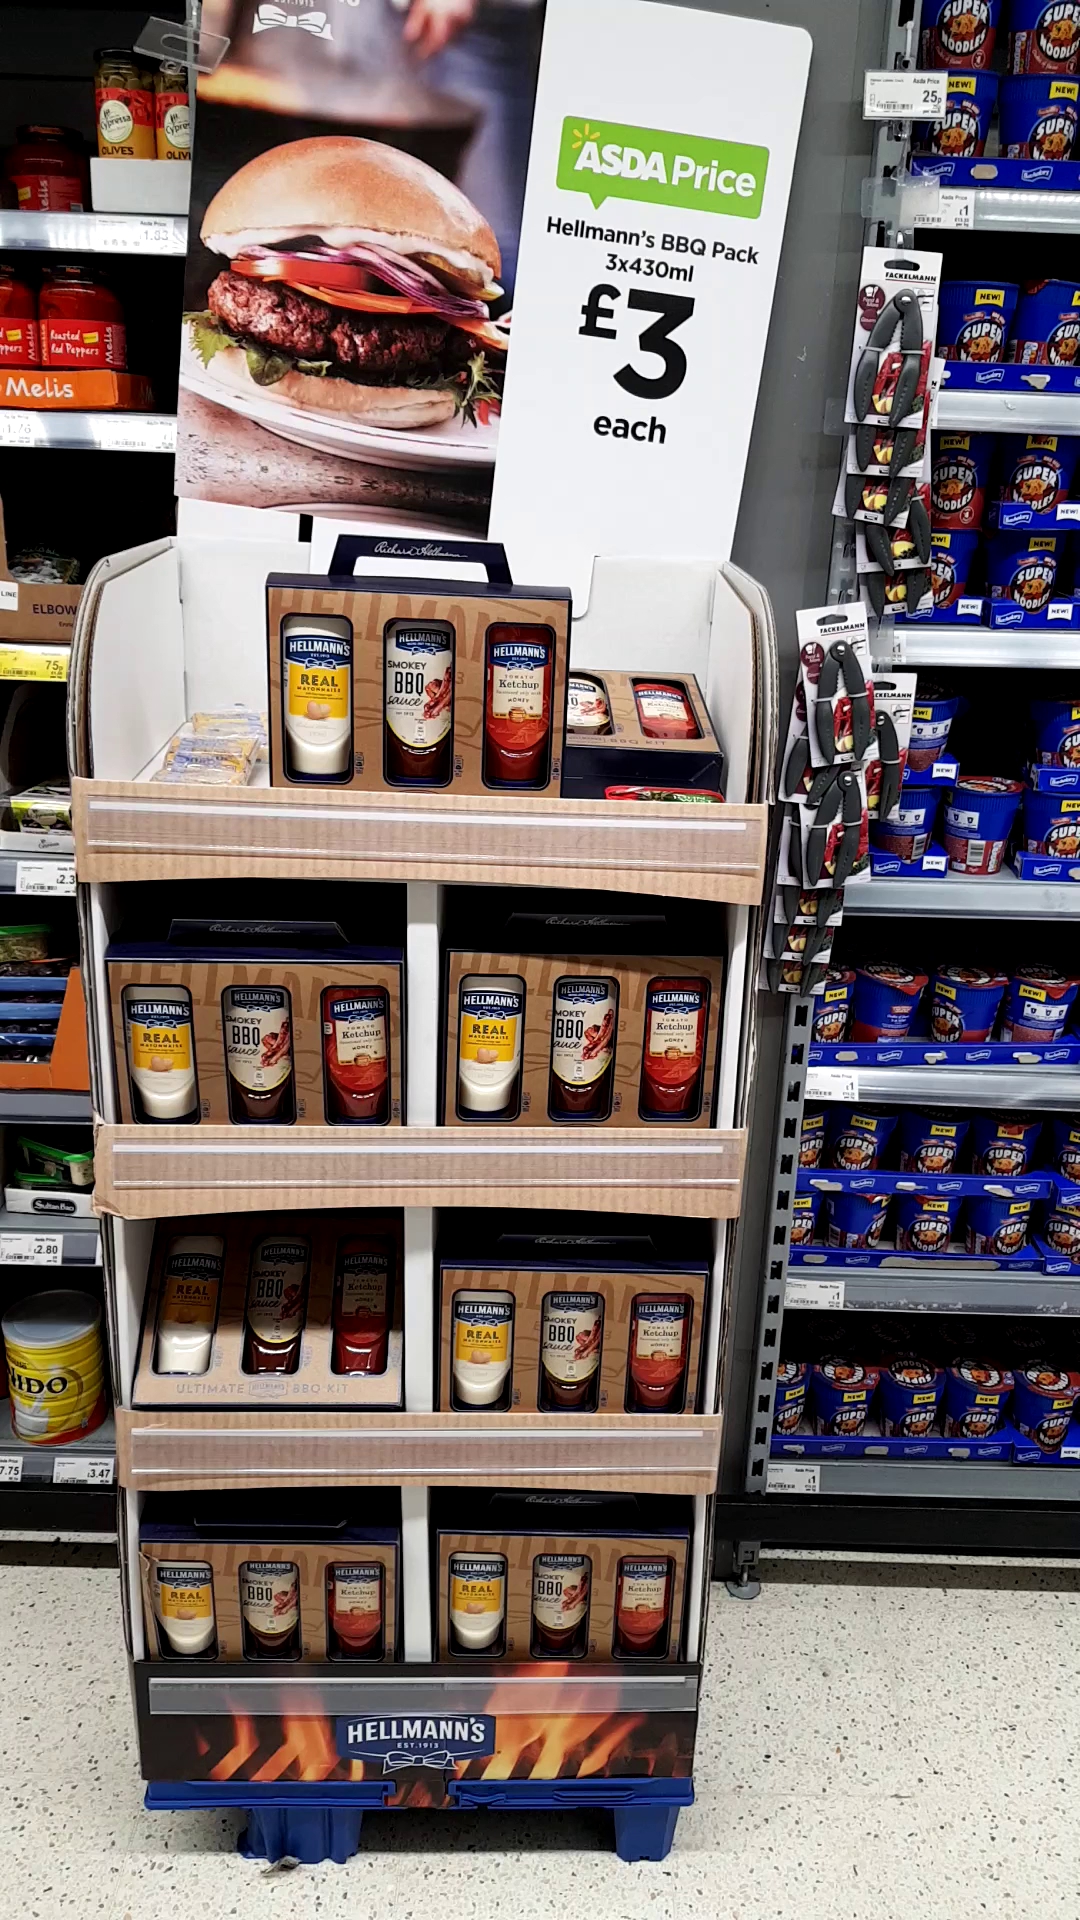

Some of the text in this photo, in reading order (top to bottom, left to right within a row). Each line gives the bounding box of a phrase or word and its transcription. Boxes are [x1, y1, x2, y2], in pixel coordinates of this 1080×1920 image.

[943, 0, 989, 23] SUPER
[941, 28, 986, 53] NOODLES
[1055, 86, 1075, 95] NEW!
[922, 91, 942, 105] 25p
[100, 115, 132, 131] Cypressa
[933, 112, 977, 137] SUPER
[1036, 119, 1074, 139] SUPER
[102, 146, 134, 155] OLIVES
[574, 141, 756, 197] ASDA Price
[547, 216, 759, 264] Hellmann's BBQ Pack
[605, 253, 694, 282] 3x430ml
[885, 272, 937, 283] FACKELMANN
[980, 293, 1001, 301] NEW!
[50, 330, 80, 341] Roasted
[963, 323, 1002, 340] SUPER
[104, 326, 113, 364] Melis
[578, 284, 695, 400] £3
[51, 342, 99, 357] Red Peppers
[6, 377, 74, 398] Melis
[593, 414, 667, 444] each
[943, 438, 966, 446] NEW!
[932, 467, 974, 485] SUPER
[1015, 466, 1058, 486] SUPER
[932, 490, 973, 512] NOODLES
[1017, 568, 1053, 584] SUPER
[1013, 589, 1049, 609] NOODLES
[33, 604, 77, 615] ELBOW
[820, 623, 865, 634] FACKELMANN
[399, 632, 447, 645] HELLMANN'S
[289, 641, 350, 656] HELLMANN'S
[493, 646, 545, 659] HELLMANN'S
[387, 660, 427, 671] SMOKEY
[301, 674, 338, 688] REAL
[394, 672, 424, 696] BBQ
[499, 679, 539, 690] Ketchup
[387, 695, 424, 707] sauce
[561, 985, 605, 995] HELLMANN'S
[828, 991, 845, 999] NEW!
[936, 984, 954, 995] NEW!
[1022, 988, 1042, 998] NEW!
[234, 993, 281, 1003] HELLMANN'S
[463, 995, 519, 1007] HELLMANN'S
[652, 993, 700, 1003] HELLMANN'S
[131, 1004, 190, 1016] HELLMANN'S
[334, 998, 384, 1013] HELLMANN'S
[225, 1015, 262, 1025] SMOKEY
[816, 1012, 848, 1028] SUPER
[932, 1006, 960, 1027] SUPER
[473, 1024, 506, 1035] REAL
[556, 1019, 583, 1040] BBQ
[656, 1023, 693, 1031] Ketchup
[143, 1033, 180, 1043] REAL
[232, 1025, 260, 1047] BBQ
[342, 1030, 381, 1039] Ketchup
[228, 1045, 260, 1056] sauce
[806, 1118, 823, 1127] NEW!
[854, 1118, 875, 1128] NEW!
[934, 1127, 954, 1135] NEW!
[839, 1136, 877, 1153] SUPER
[919, 1147, 955, 1162] SUPER
[987, 1149, 1024, 1165] SUPER
[1012, 1203, 1029, 1212] NEW!
[914, 1220, 948, 1234] SUPER
[1000, 1222, 1027, 1235] SUPER
[1048, 1223, 1080, 1235] SUPER
[176, 1284, 208, 1295] REAL
[257, 1279, 283, 1299] BBQ
[347, 1283, 383, 1291] Ketchup
[553, 1296, 595, 1304] HELLMANN'S
[458, 1305, 510, 1316] HELLMANN'S
[639, 1304, 684, 1313] HELLMANN'S
[544, 1316, 577, 1324] SMOKEY
[467, 1330, 499, 1339] REAL
[549, 1325, 574, 1343] BBQ
[643, 1329, 678, 1337] Ketchup
[542, 1342, 574, 1351] sauce
[177, 1383, 349, 1394] ULTIMATE BBQ KIT
[788, 1389, 804, 1398] NEW!
[777, 1407, 804, 1422] SUPER
[835, 1411, 865, 1424] SUPER
[905, 1411, 935, 1424] SUPER
[965, 1413, 996, 1425] SUPER
[1042, 1417, 1070, 1429] SUPER
[335, 1567, 380, 1576] HELLMANN'S
[454, 1563, 503, 1572] HELLMANN'S
[624, 1564, 667, 1572] HELLMANN'S
[160, 1570, 211, 1579] HELLMANN'S
[248, 1586, 272, 1602] BBQ
[462, 1585, 492, 1593] REAL
[538, 1580, 562, 1596] BBQ
[348, 1717, 486, 1744] HELLMANN'S
